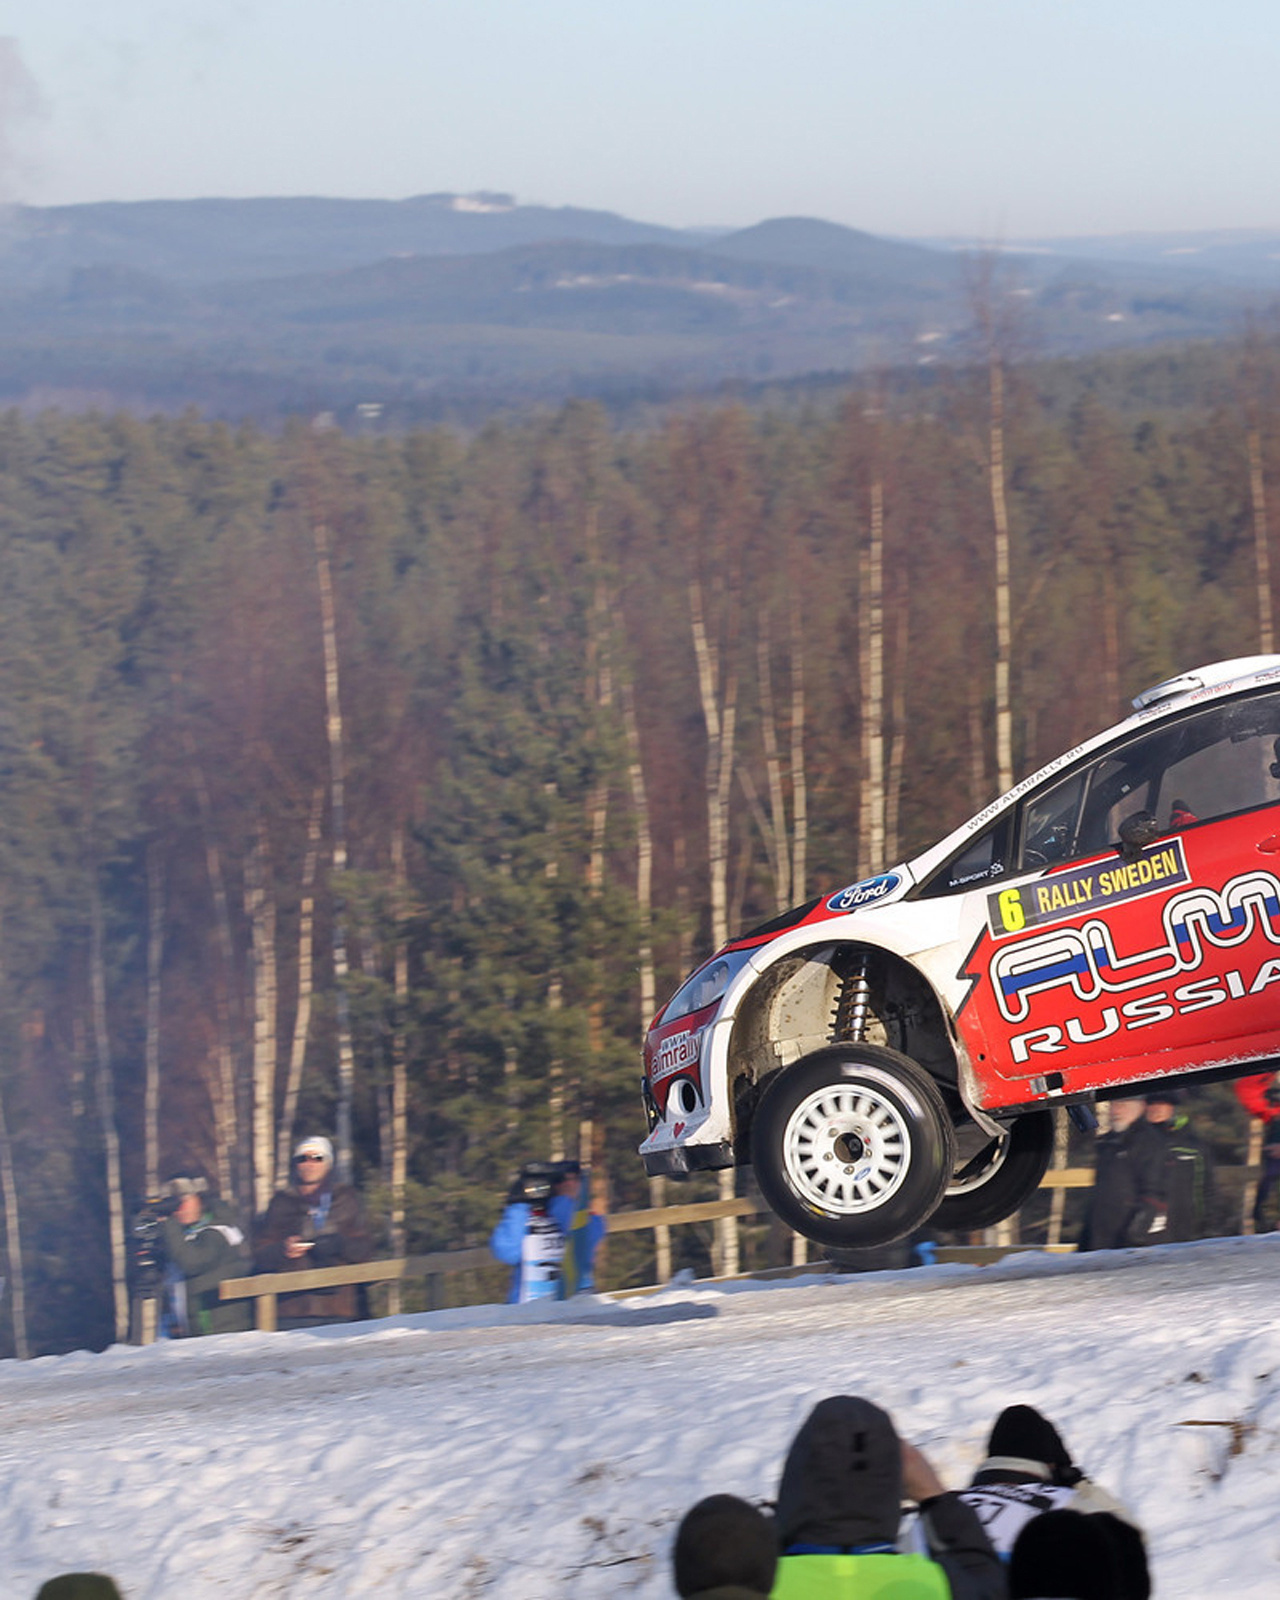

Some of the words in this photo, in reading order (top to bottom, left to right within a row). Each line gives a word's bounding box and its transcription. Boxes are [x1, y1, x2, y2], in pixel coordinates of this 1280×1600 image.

[840, 880, 889, 908] Ford
[1036, 876, 1094, 915] RALLY
[1098, 848, 1179, 896] SWEDEN
[998, 888, 1025, 932] 6
